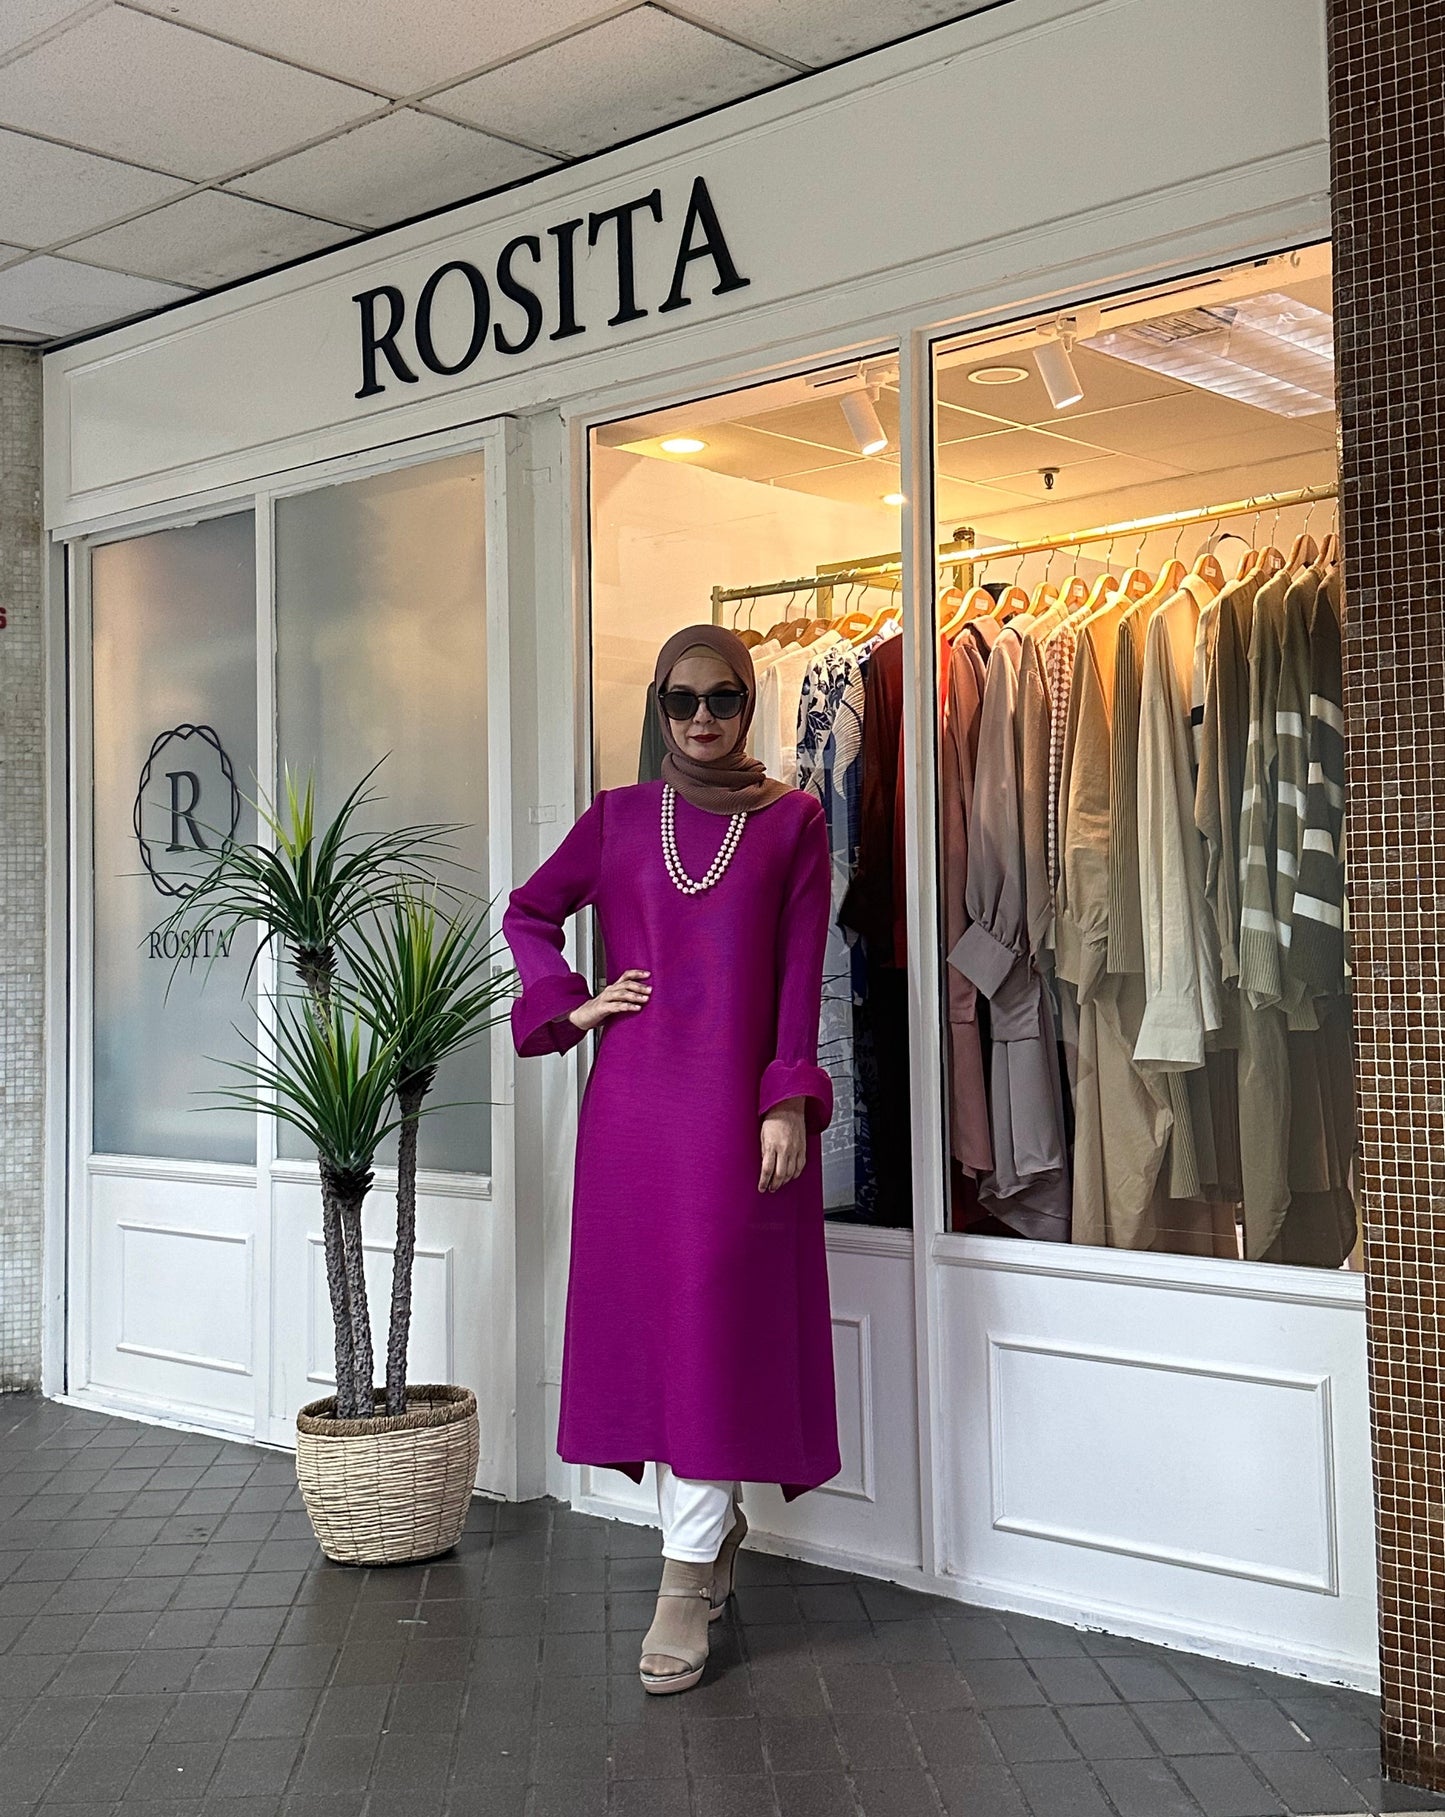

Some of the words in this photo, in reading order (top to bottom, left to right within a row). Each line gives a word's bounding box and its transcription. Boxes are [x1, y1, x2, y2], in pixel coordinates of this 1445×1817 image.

[353, 176, 750, 398] ROSITA
[165, 770, 208, 852] R
[148, 929, 229, 959] ROSITA
